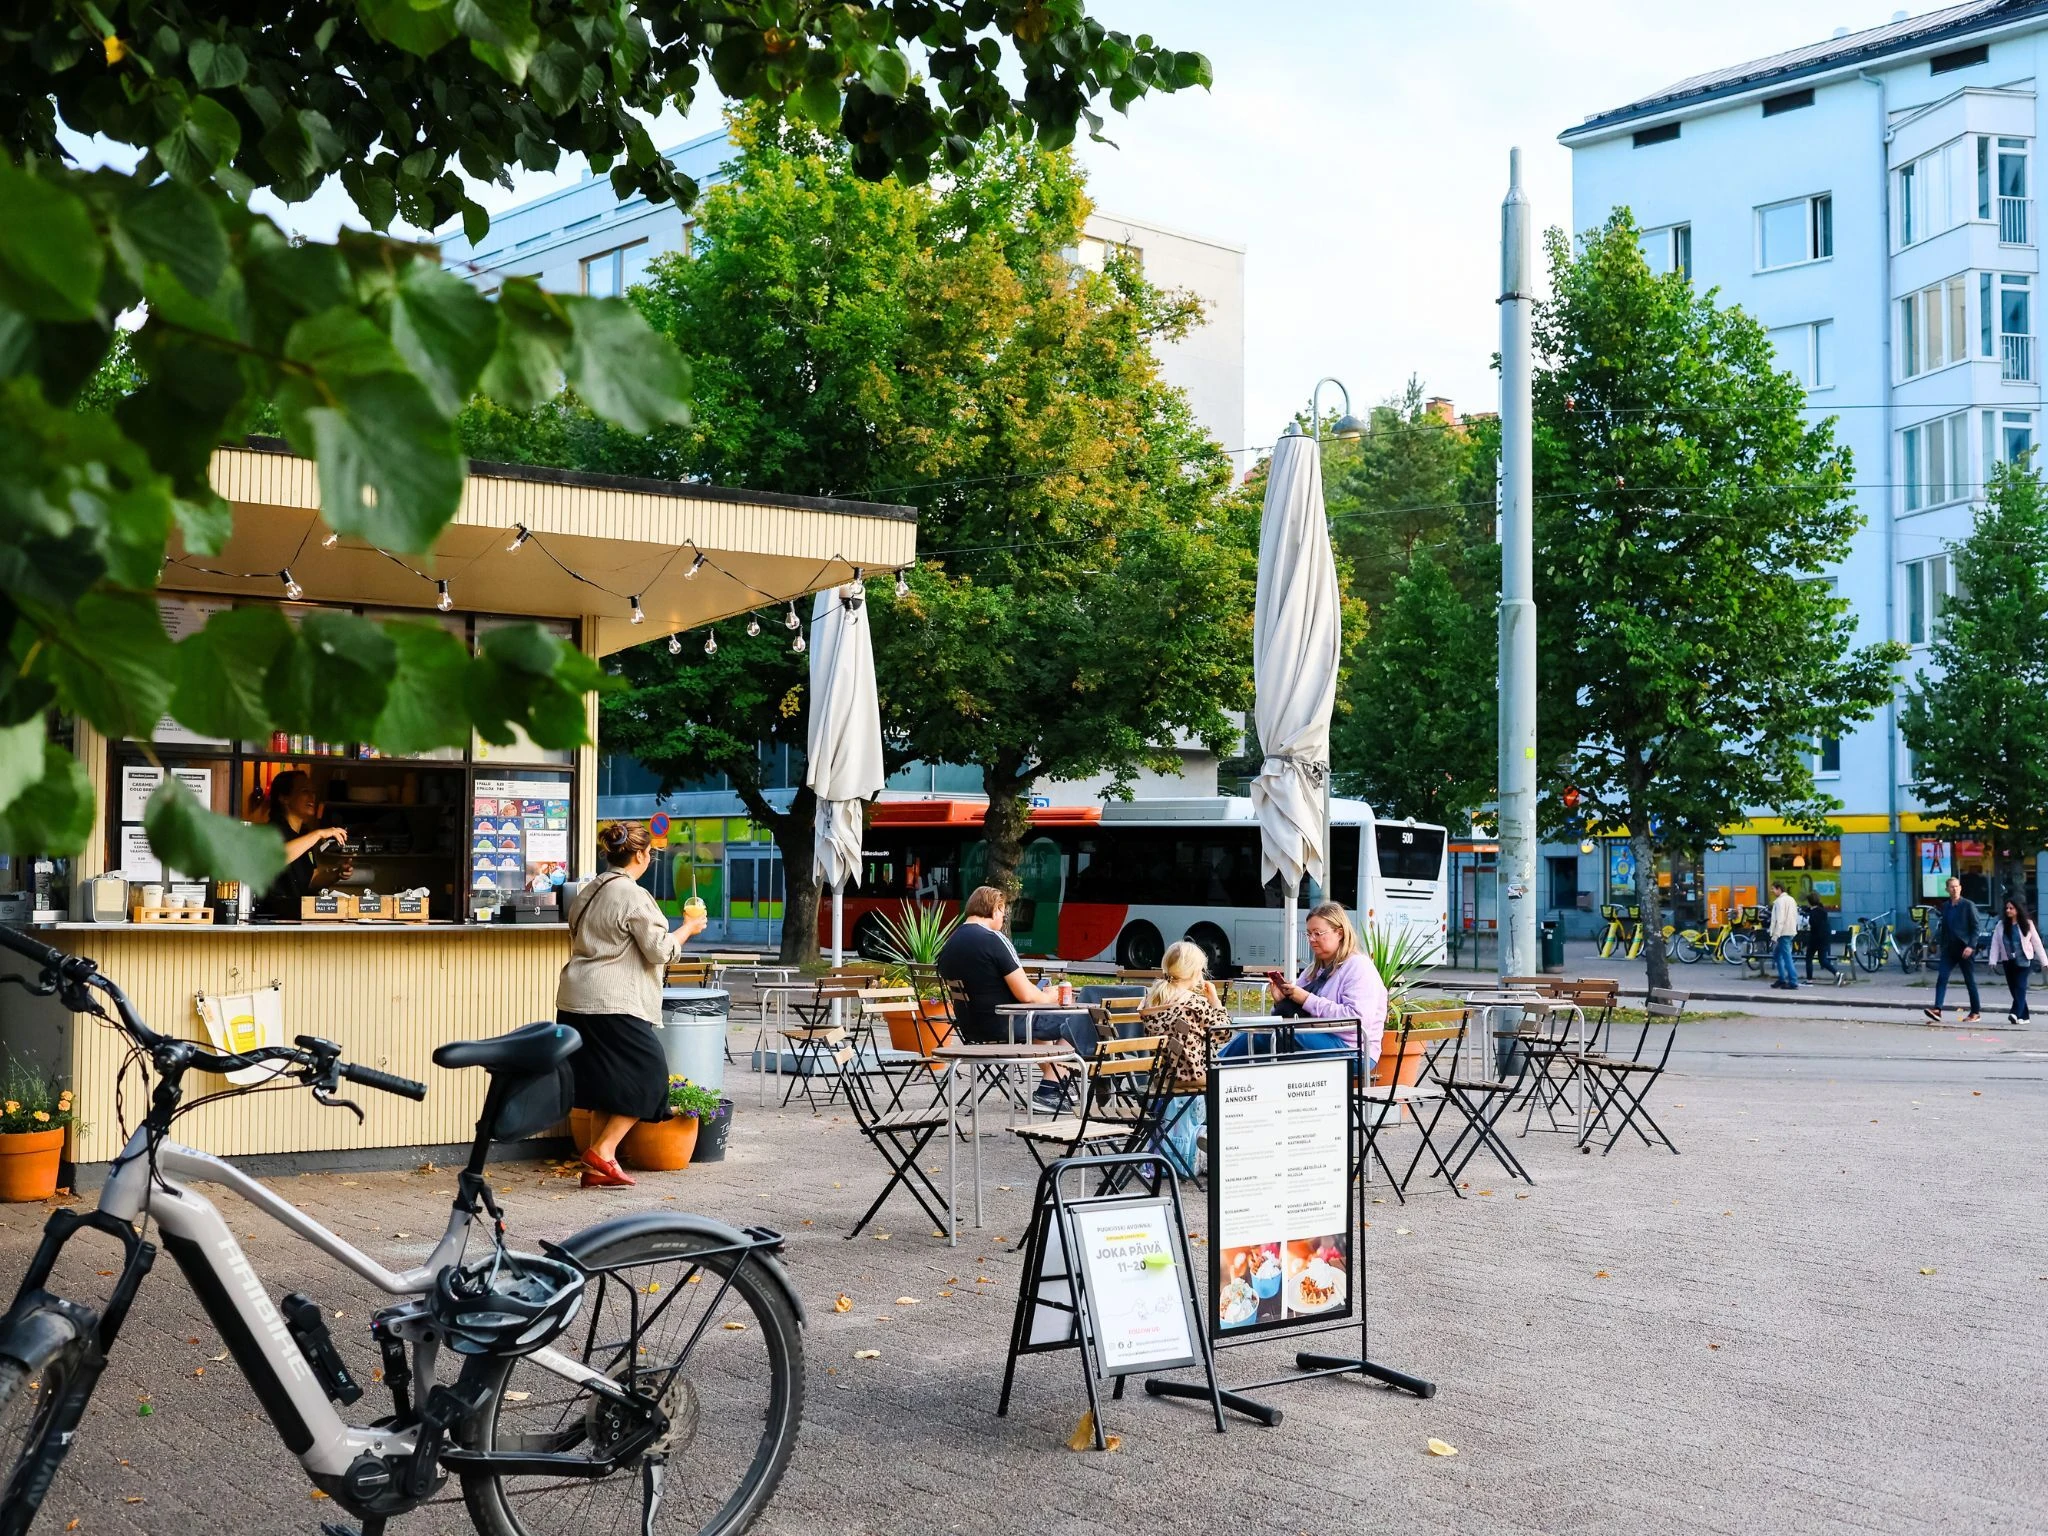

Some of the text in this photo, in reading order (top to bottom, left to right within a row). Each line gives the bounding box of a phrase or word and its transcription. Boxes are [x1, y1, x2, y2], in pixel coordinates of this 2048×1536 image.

[1402, 832, 1413, 844] 500
[1710, 903, 1719, 925] posti
[1287, 1080, 1327, 1090] BELGIALAISET
[1225, 1094, 1258, 1103] ANNOKSET
[1287, 1090, 1316, 1098] VOHVELIT
[1096, 1240, 1163, 1260] JOKA PÄIVÄ
[217, 1238, 313, 1383] HAIBIKE
